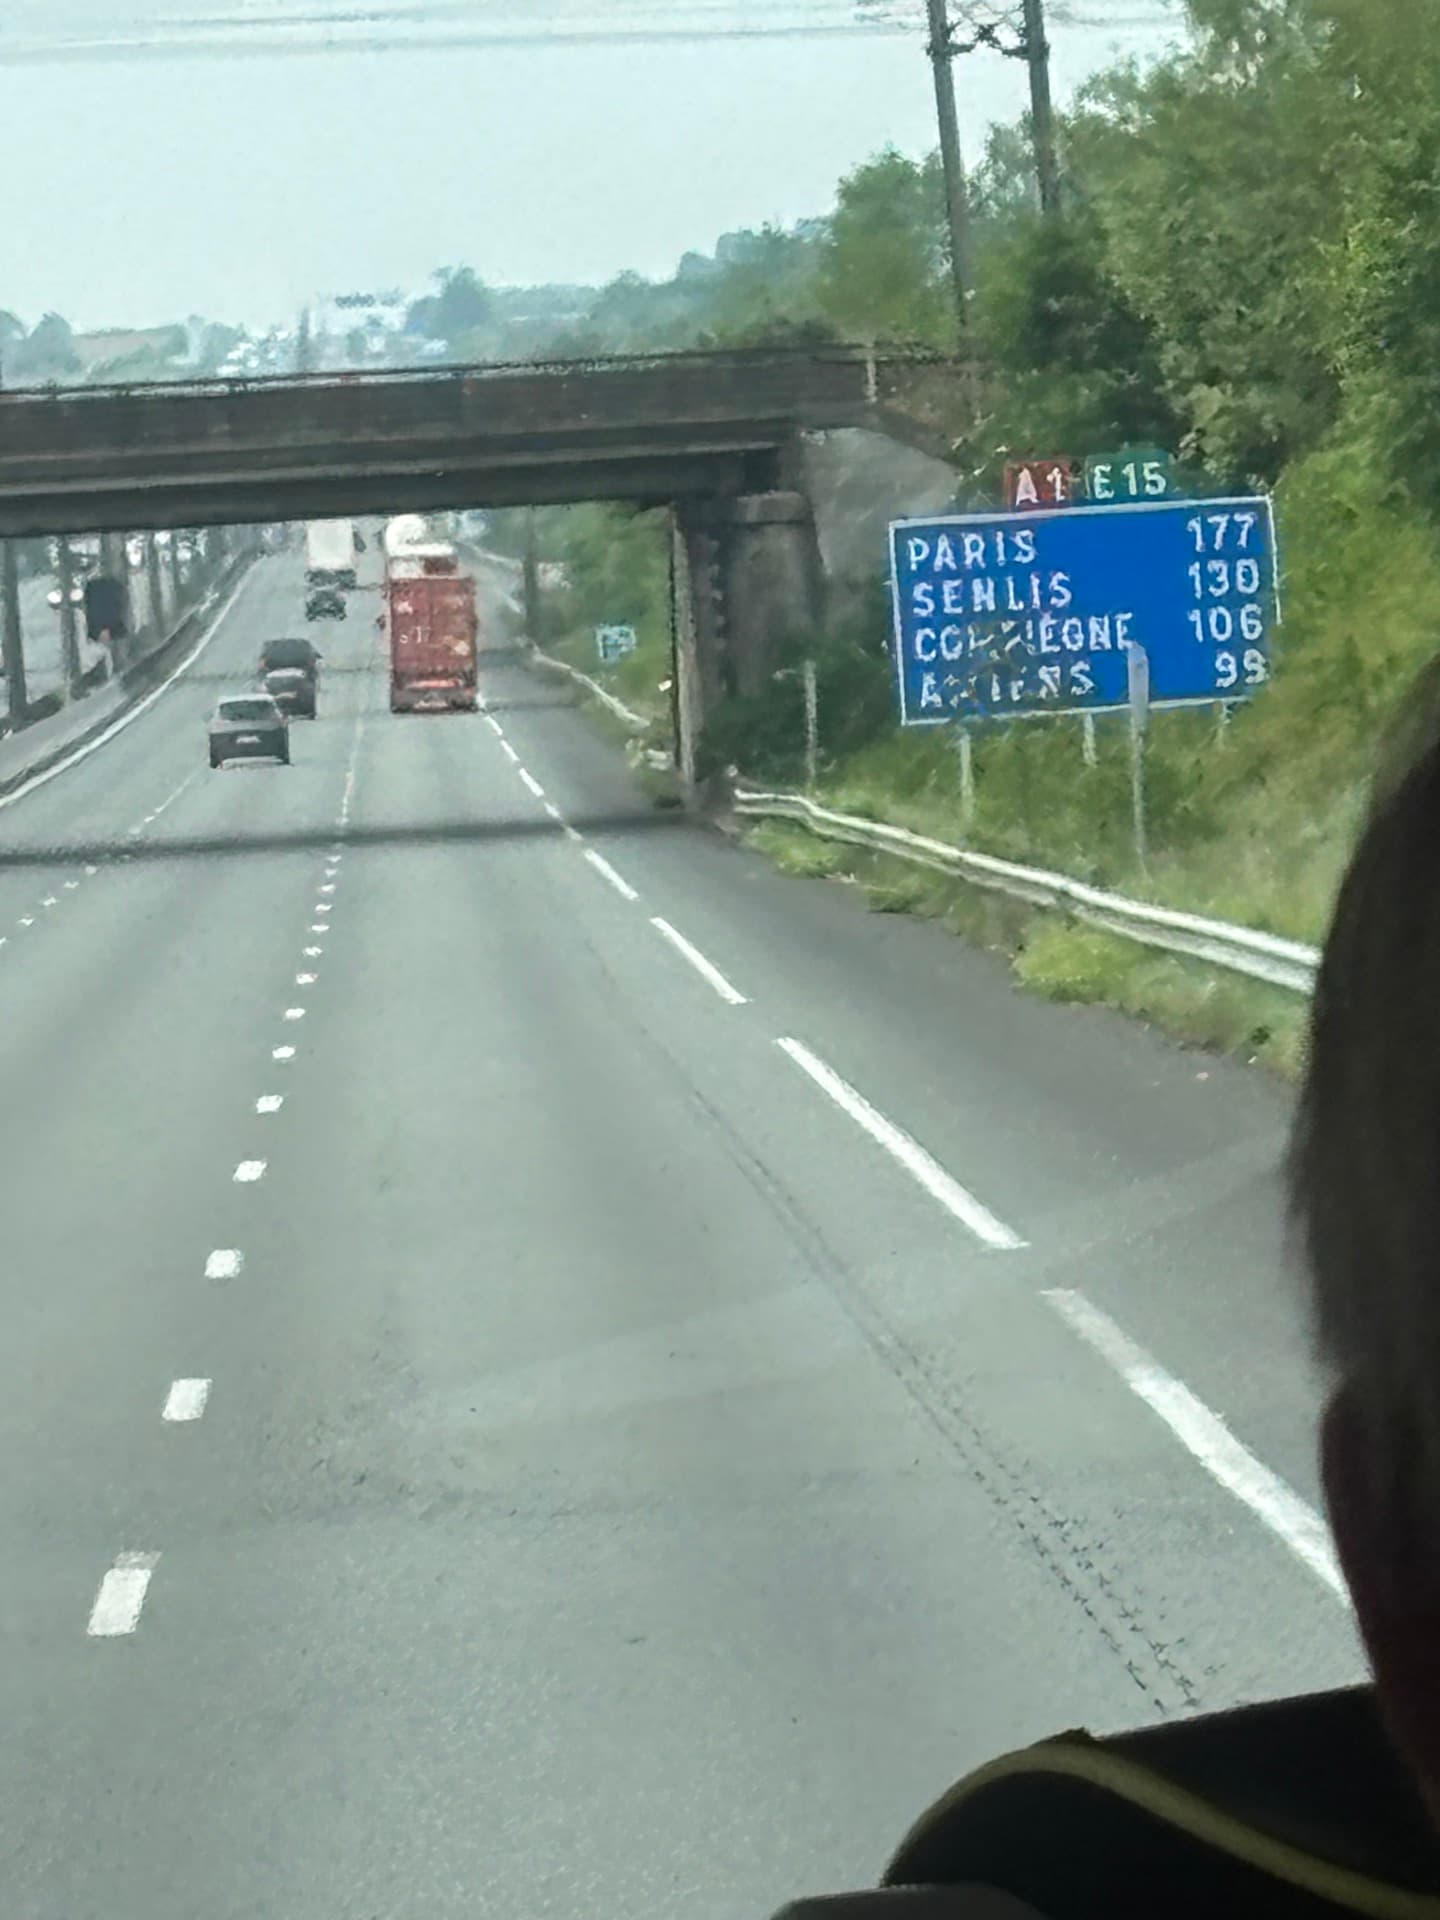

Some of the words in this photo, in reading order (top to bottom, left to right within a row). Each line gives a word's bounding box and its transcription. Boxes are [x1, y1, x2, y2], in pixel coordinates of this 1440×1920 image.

[907, 529, 1038, 571] PARIS
[1186, 512, 1257, 552] 177
[912, 572, 1073, 616] SENLIS
[1188, 559, 1260, 599] 130
[1187, 603, 1263, 642] 106
[1214, 649, 1270, 688] 99
